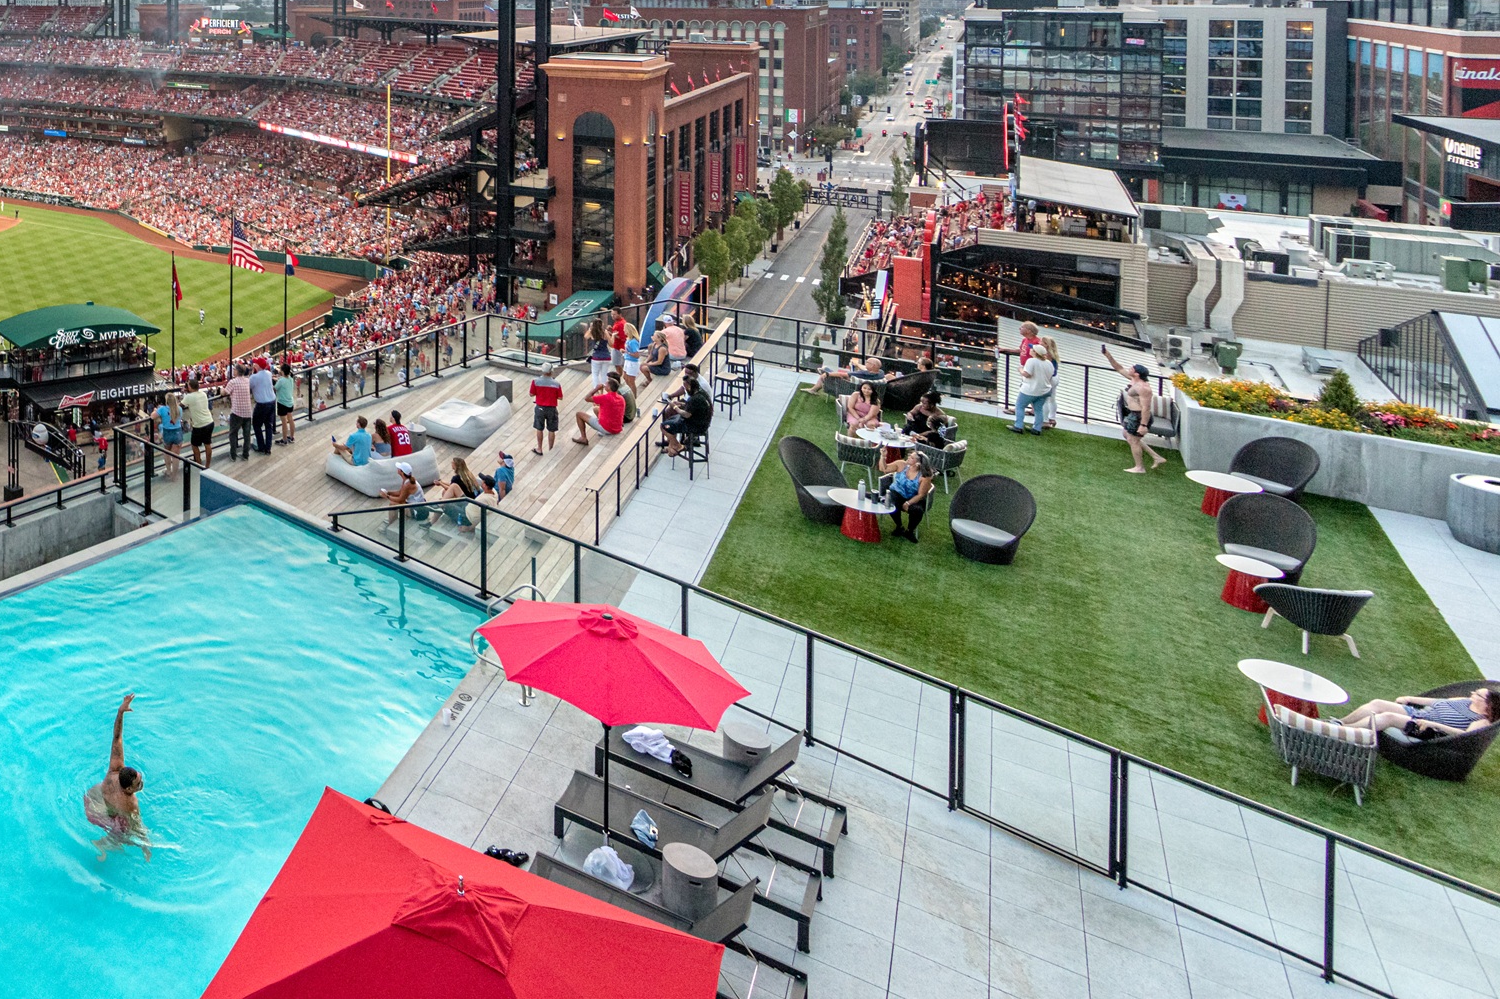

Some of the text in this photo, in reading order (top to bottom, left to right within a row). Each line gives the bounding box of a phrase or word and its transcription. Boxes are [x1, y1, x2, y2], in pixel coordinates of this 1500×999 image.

[200, 17, 239, 28] PERFICIENT
[1447, 154, 1480, 169] FITNESS
[99, 328, 137, 341] MVP Deck
[100, 383, 153, 400] EIGHTEEN
[397, 432, 411, 445] 28
